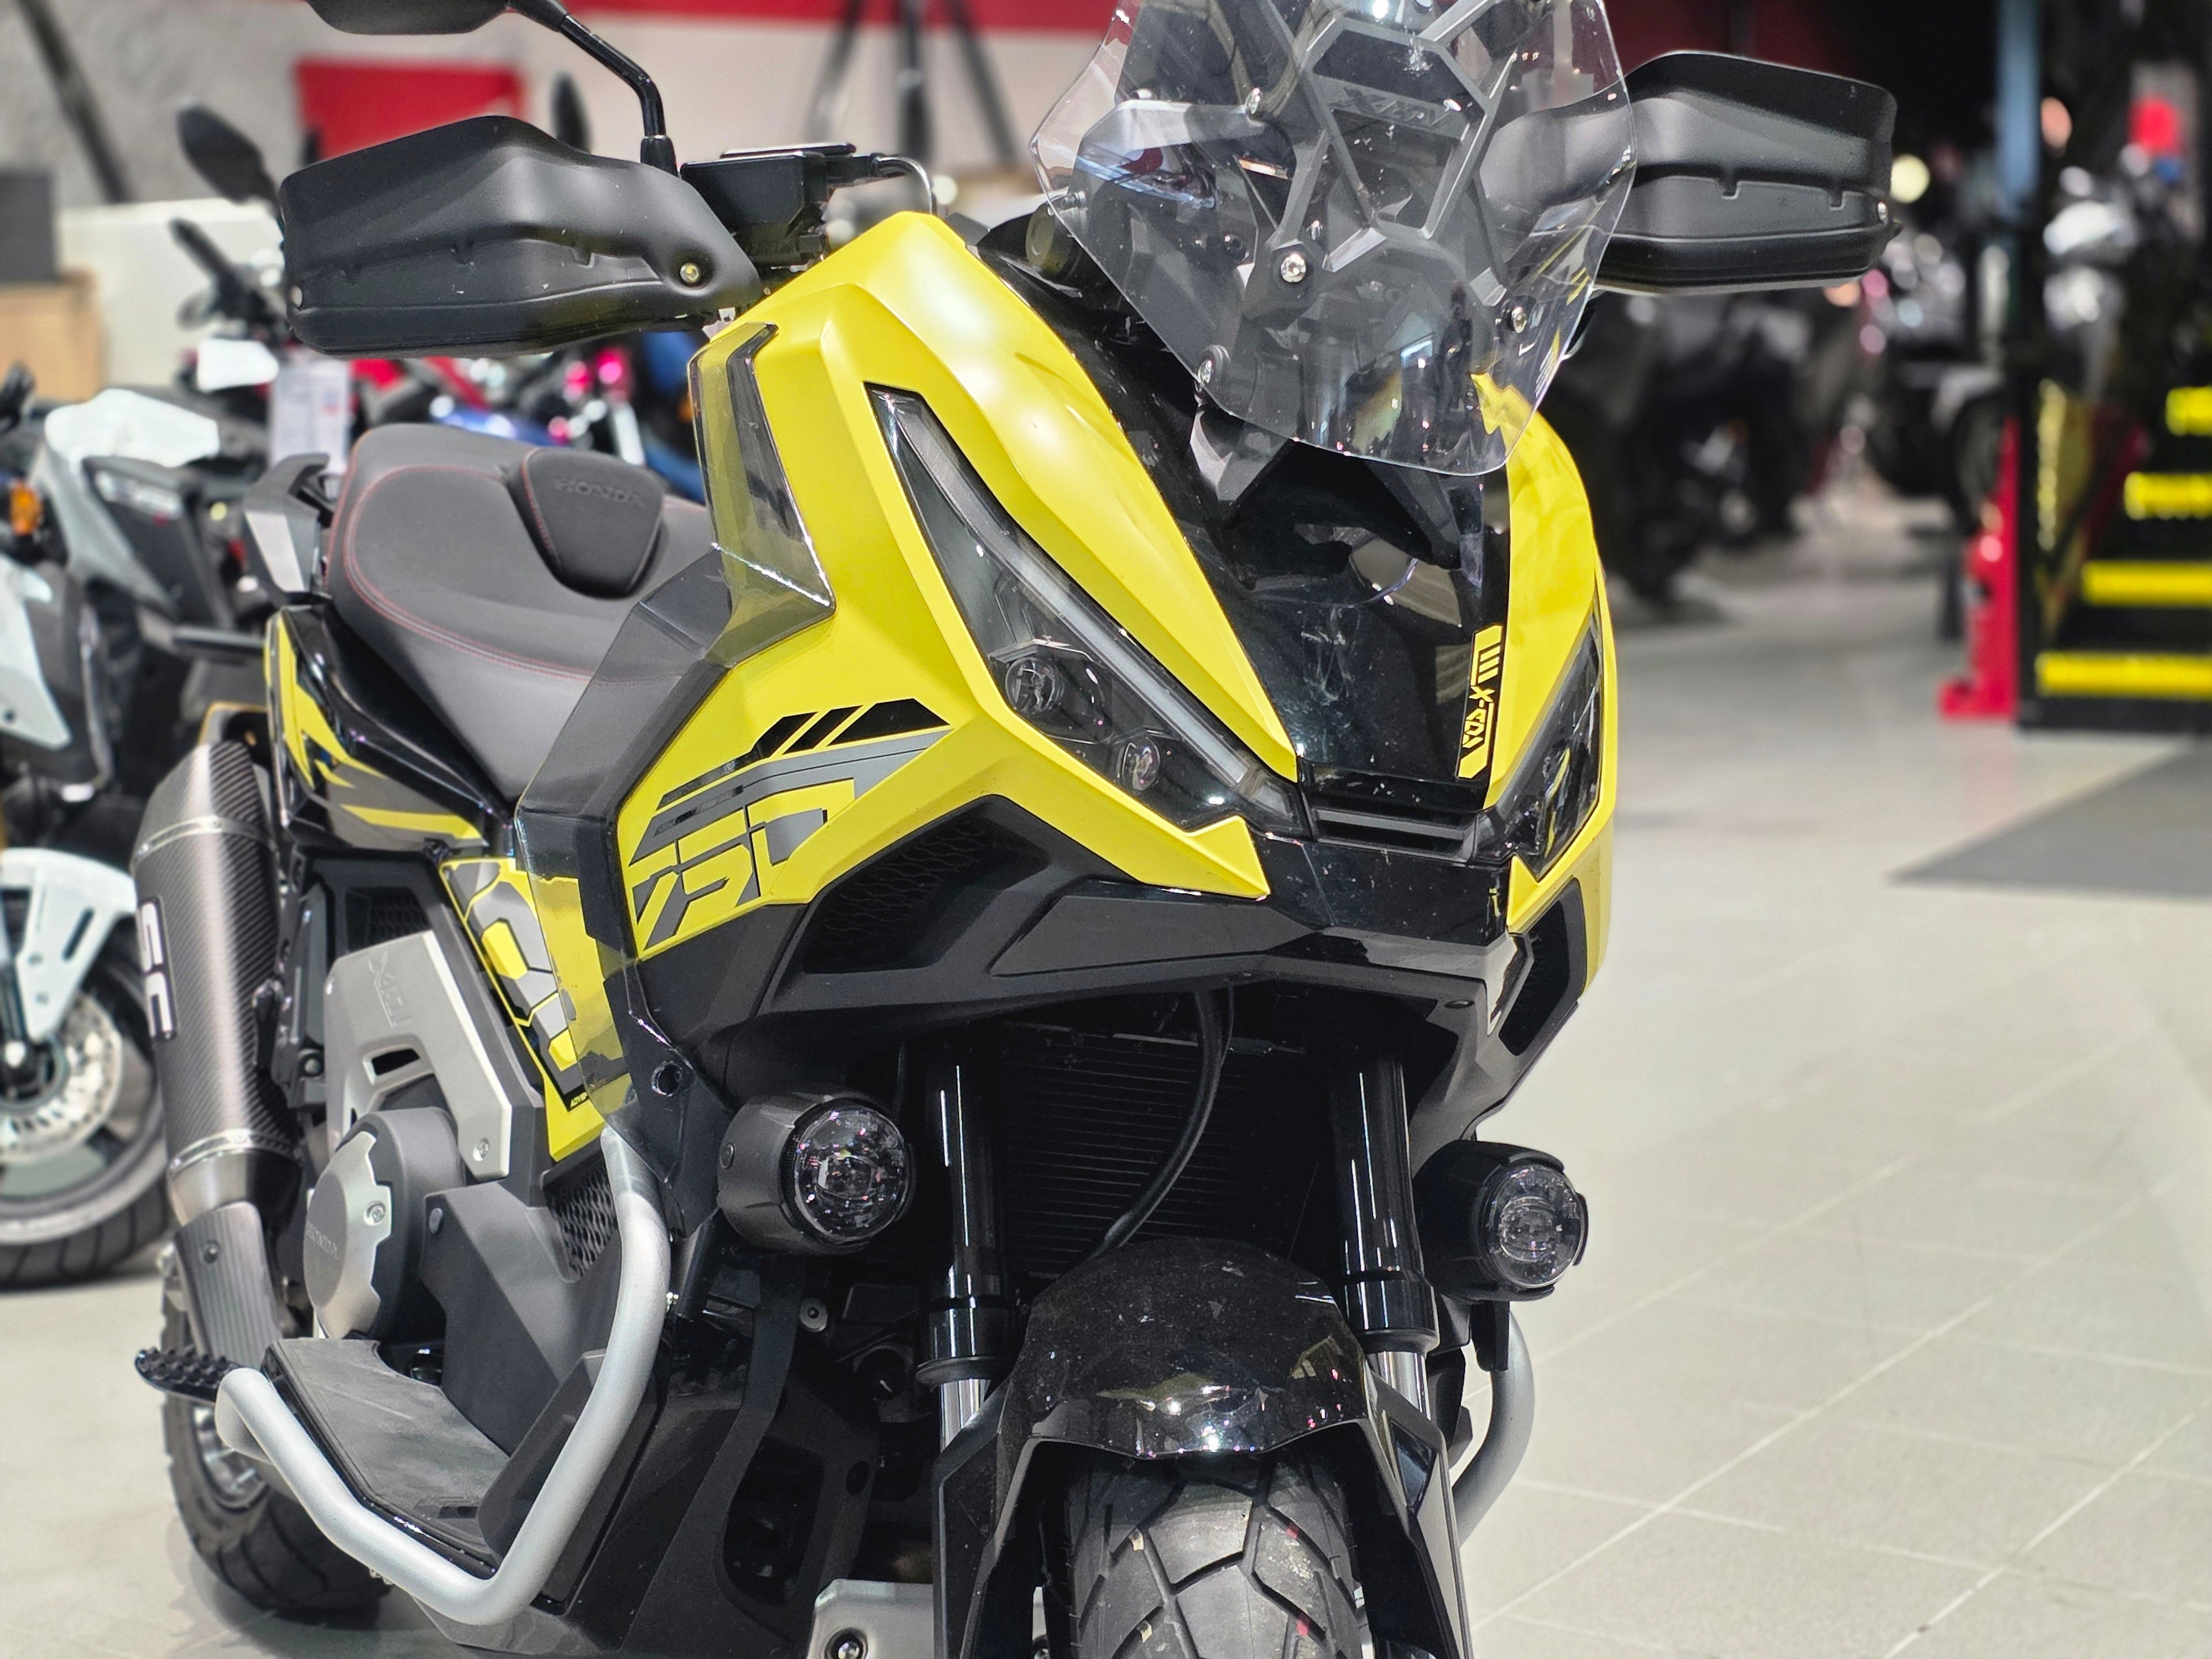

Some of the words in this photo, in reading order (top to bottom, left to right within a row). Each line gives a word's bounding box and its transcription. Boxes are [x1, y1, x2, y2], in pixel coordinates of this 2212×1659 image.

[554, 475, 646, 509] HONDA
[1462, 686, 1495, 748] X-ADV
[629, 777, 855, 952] 750
